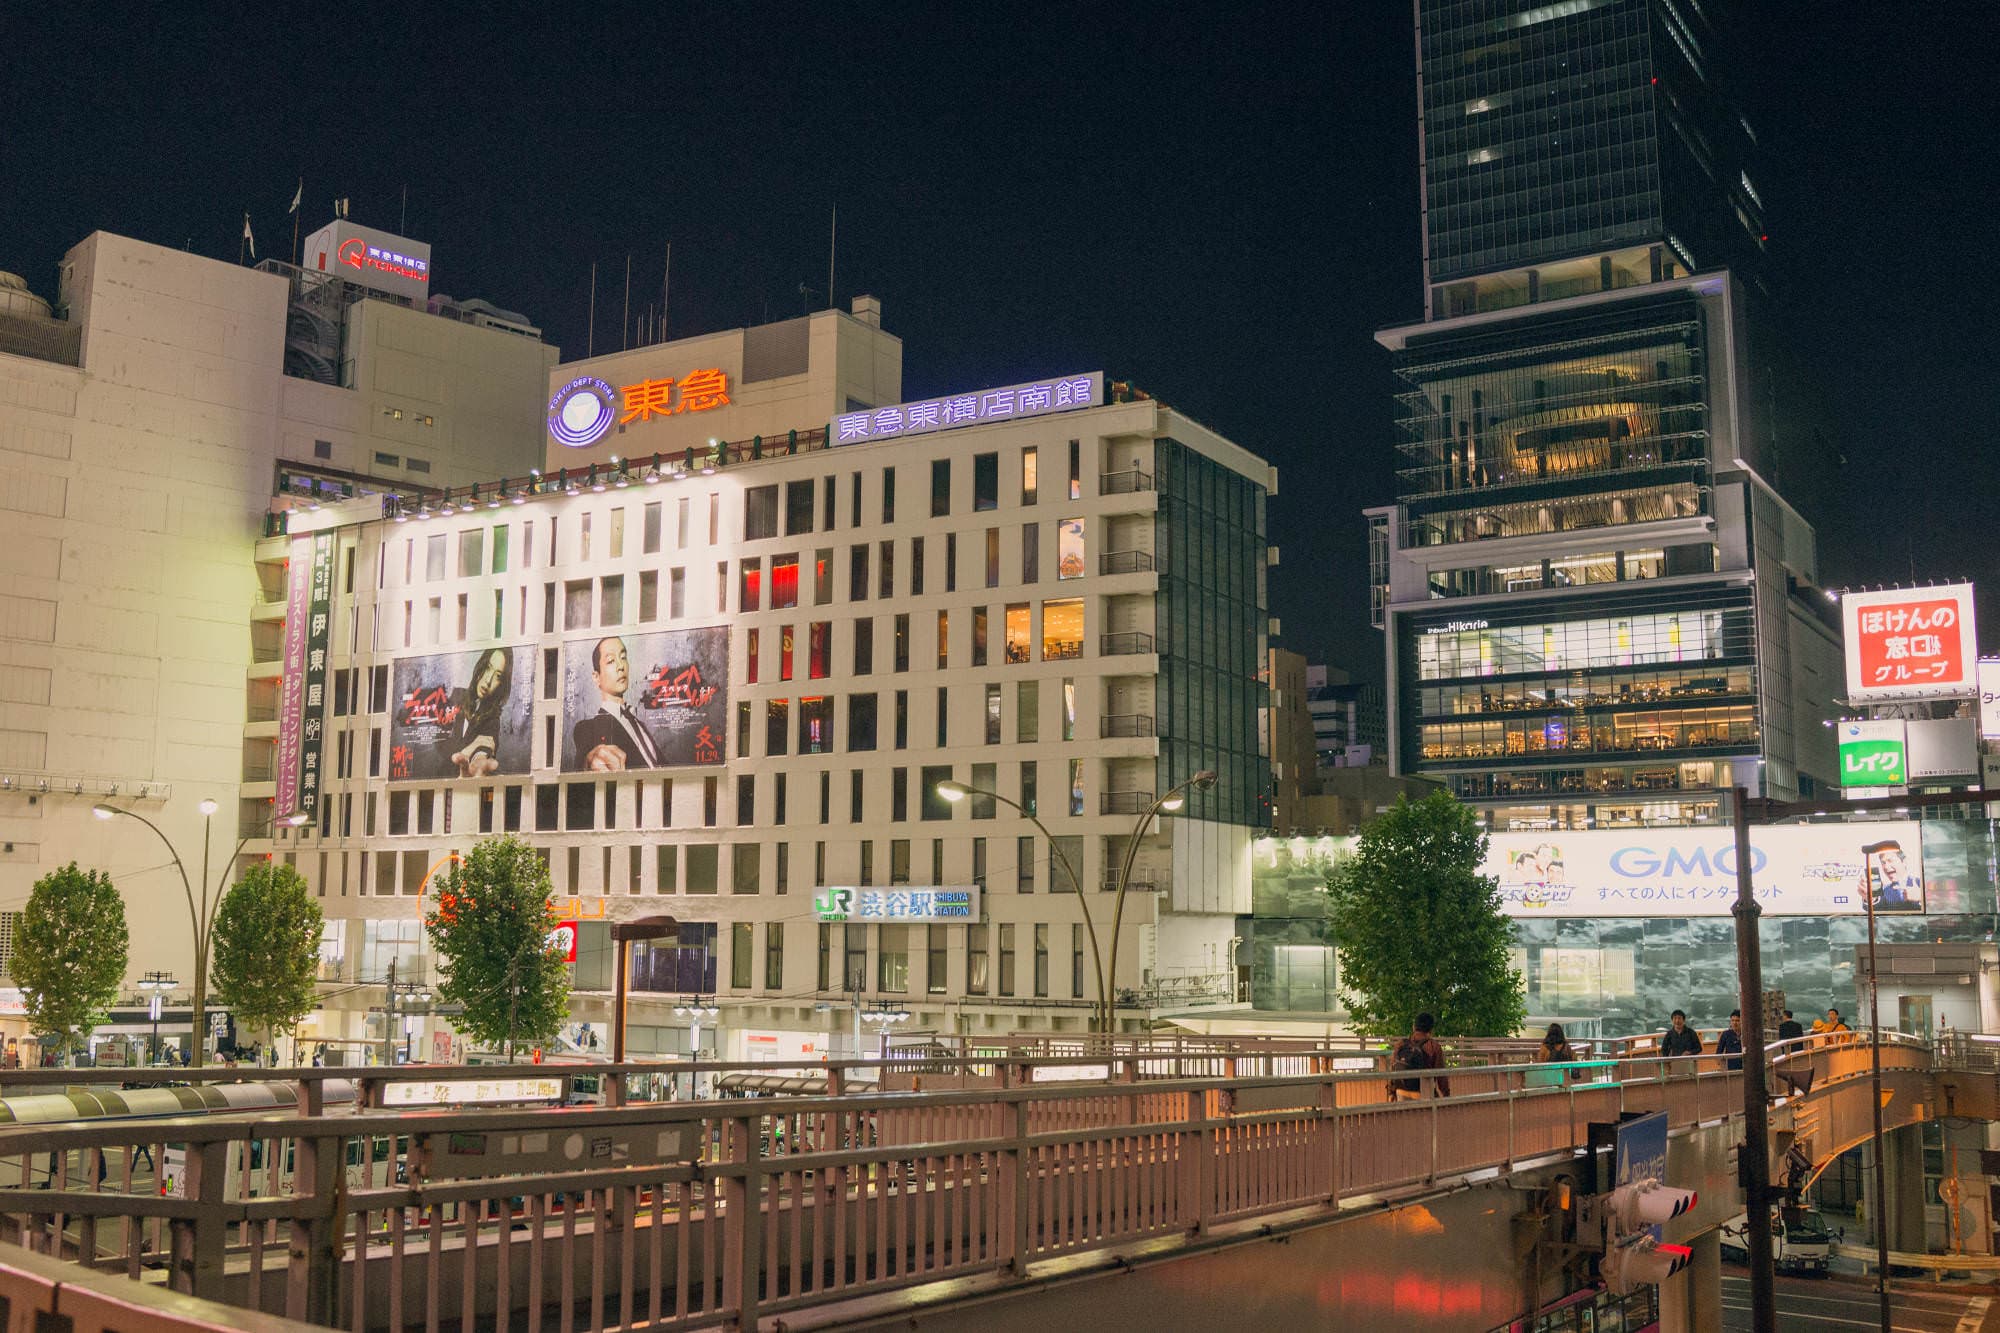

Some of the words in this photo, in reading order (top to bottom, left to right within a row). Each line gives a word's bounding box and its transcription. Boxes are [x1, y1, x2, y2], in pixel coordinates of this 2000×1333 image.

[550, 385, 572, 410] TOKYU
[572, 377, 593, 389] DEPT
[594, 379, 615, 401] STORE
[619, 367, 731, 425] 東急
[838, 376, 1092, 440] 東急東横店南館
[1861, 607, 1956, 634] ほけんの
[1885, 634, 1941, 659] 窓口
[308, 613, 327, 707] 伊東屋
[1875, 660, 1949, 682] グループ
[1845, 752, 1899, 772] レイク
[303, 752, 317, 810] 営業中
[1609, 845, 1767, 878] GMO
[815, 888, 852, 912] JR
[860, 892, 931, 917] 渋谷駅
[934, 892, 969, 901] SHIBUYA
[934, 906, 969, 917] STATION
